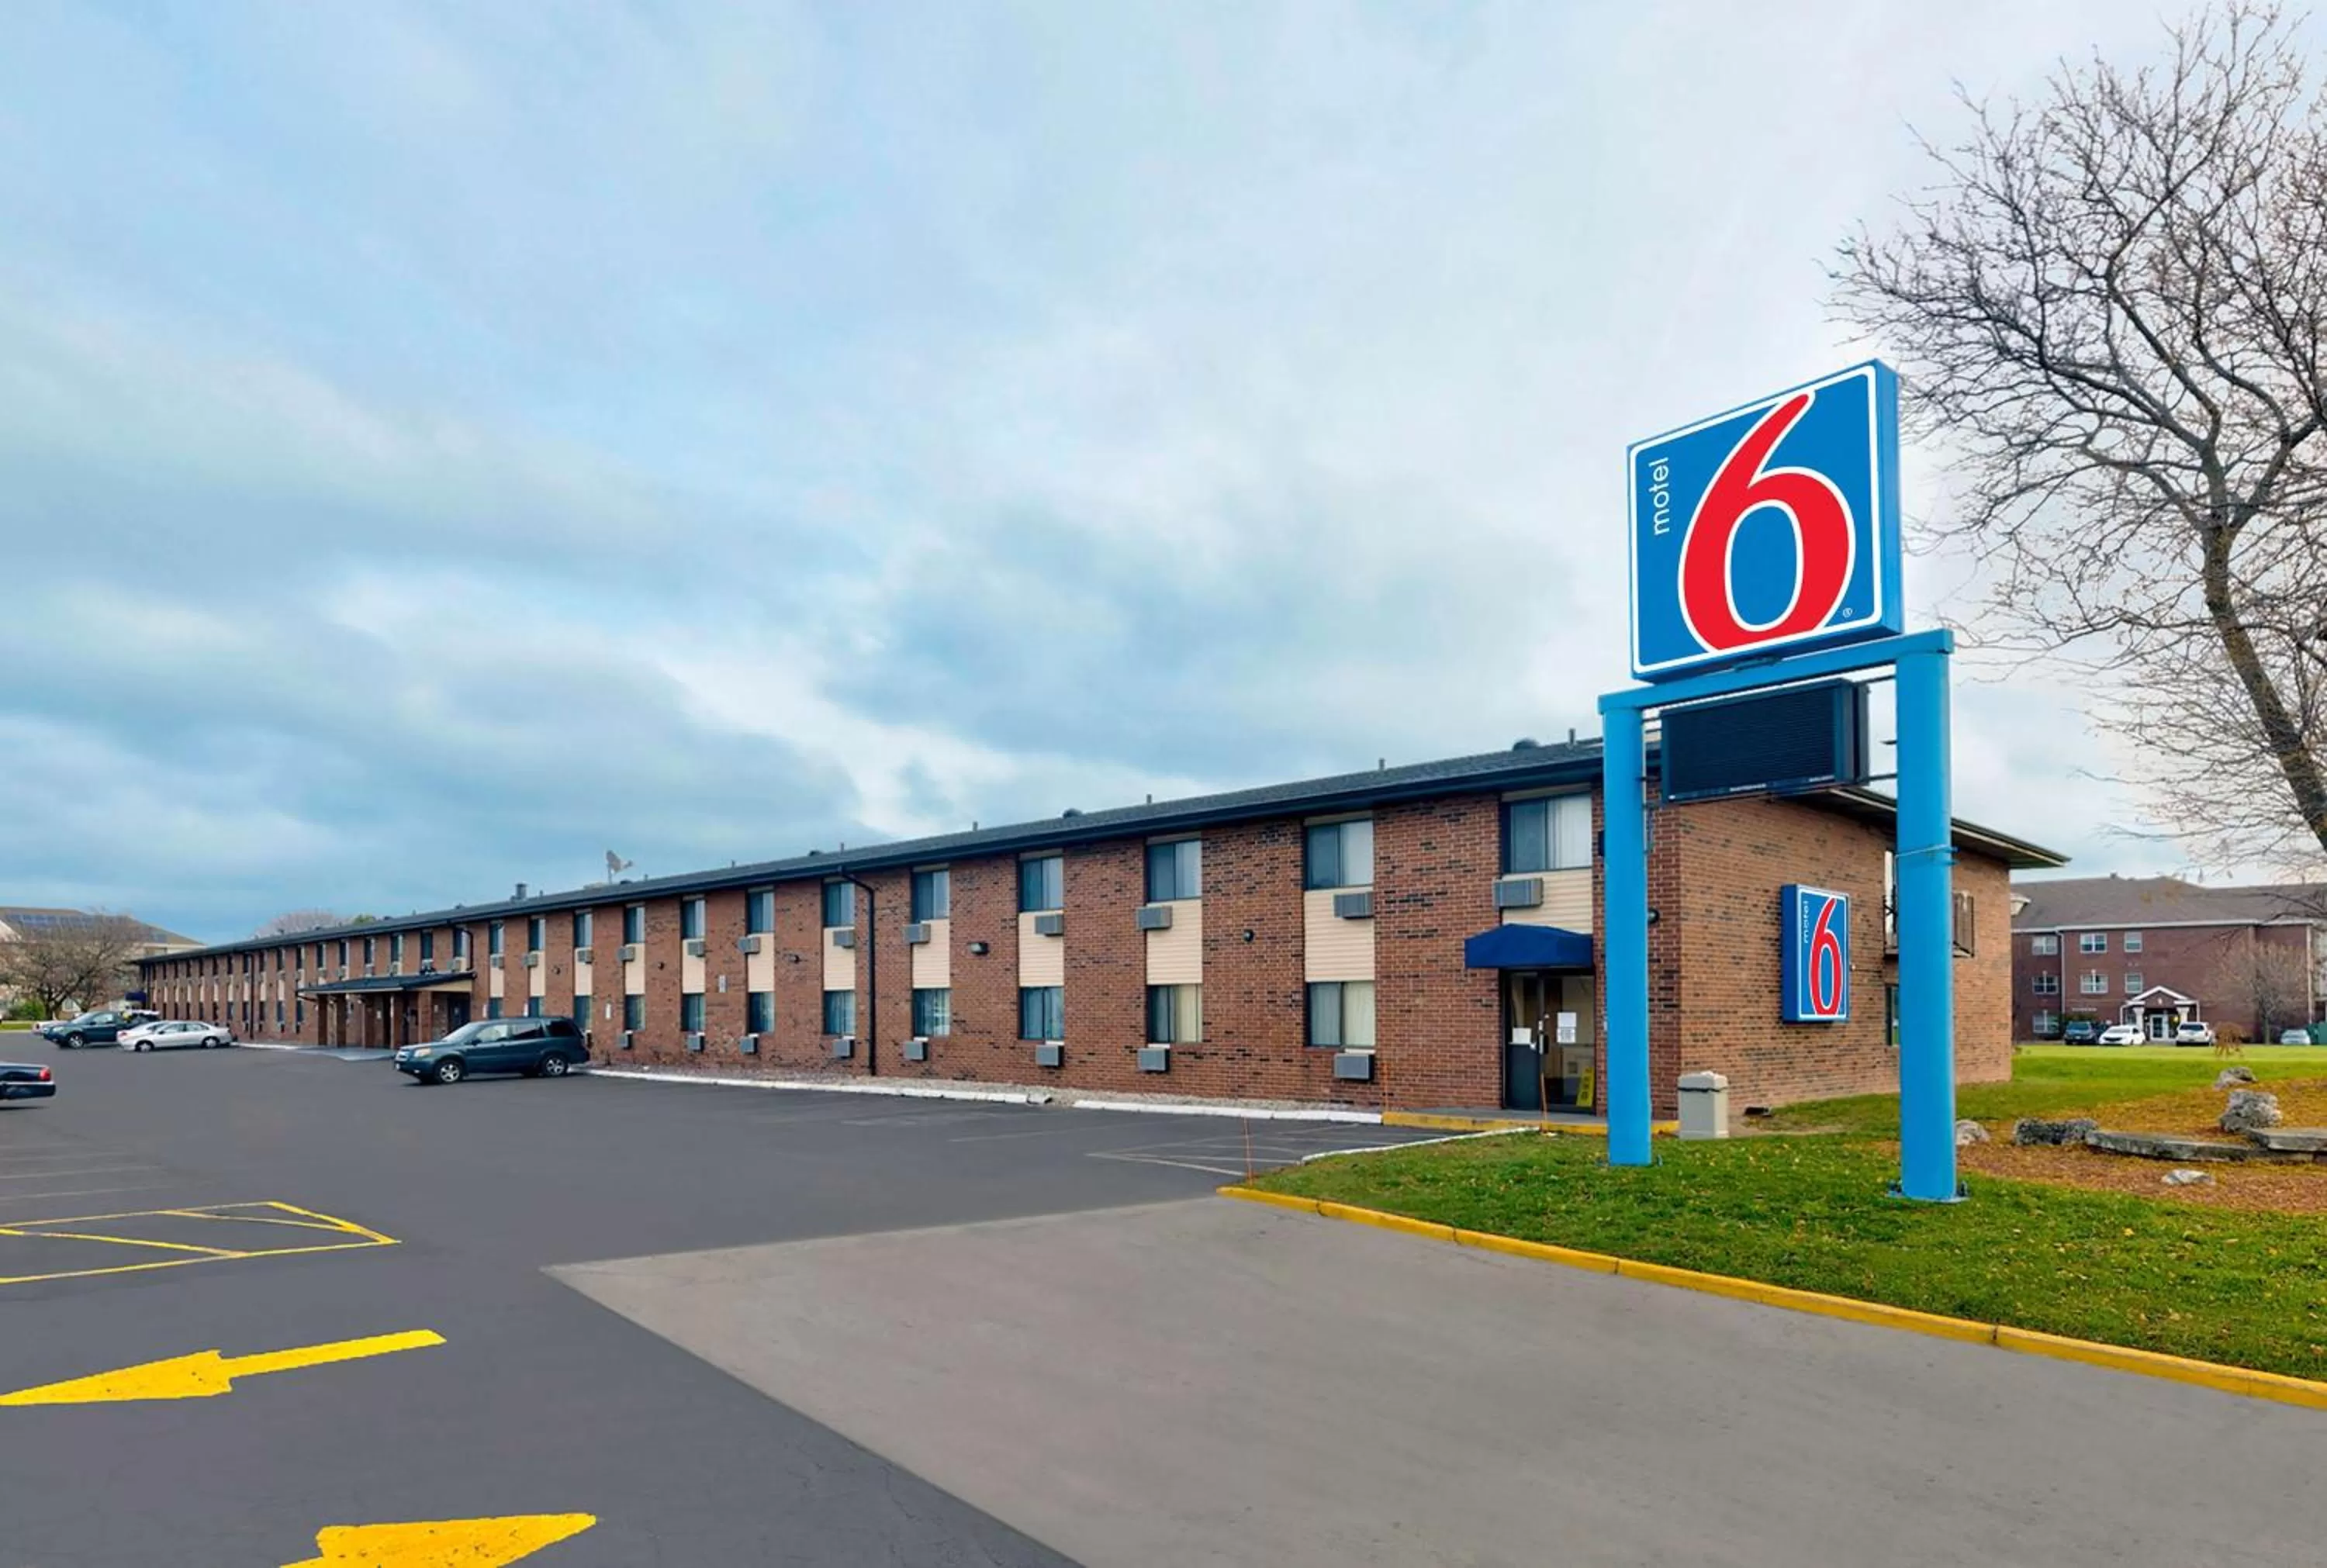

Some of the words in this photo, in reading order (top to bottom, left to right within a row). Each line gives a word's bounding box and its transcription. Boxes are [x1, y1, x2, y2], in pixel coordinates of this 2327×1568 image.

[1648, 457, 1669, 536] motel
[1679, 390, 1855, 653] 6
[1809, 896, 1843, 1016] 6
